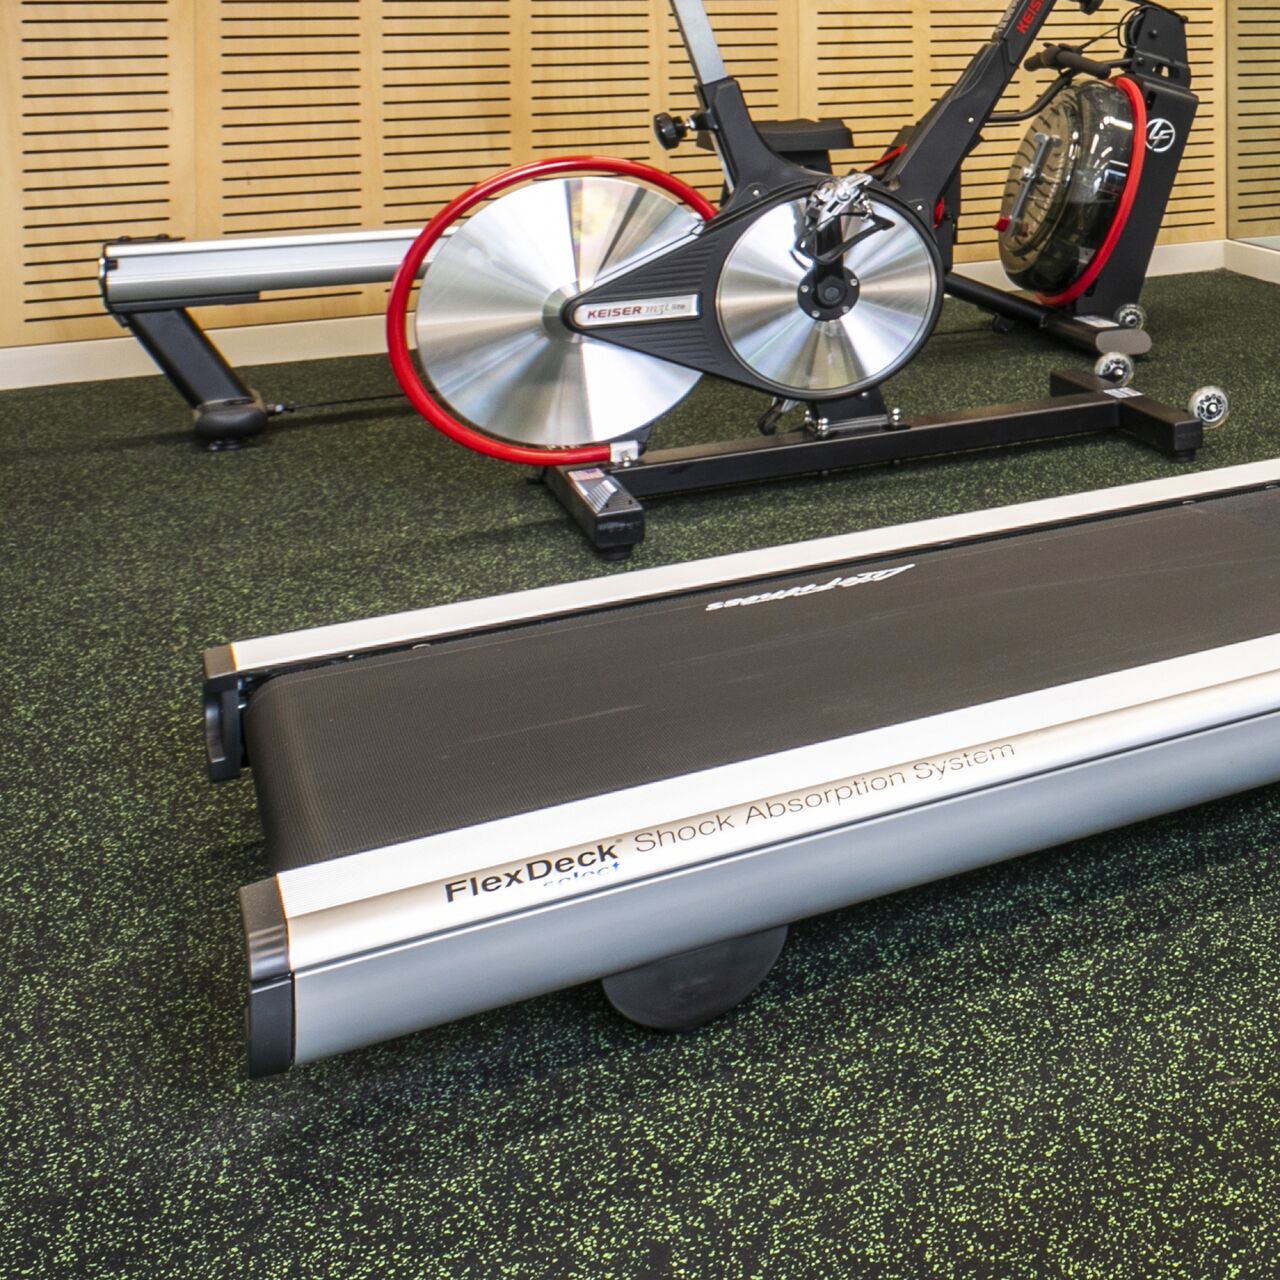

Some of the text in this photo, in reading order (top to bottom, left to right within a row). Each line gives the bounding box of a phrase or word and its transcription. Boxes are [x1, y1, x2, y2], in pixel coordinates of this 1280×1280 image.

[587, 305, 642, 320] KEISER
[633, 813, 735, 852] Shock
[745, 769, 907, 825] Absorption
[912, 741, 1015, 781] System
